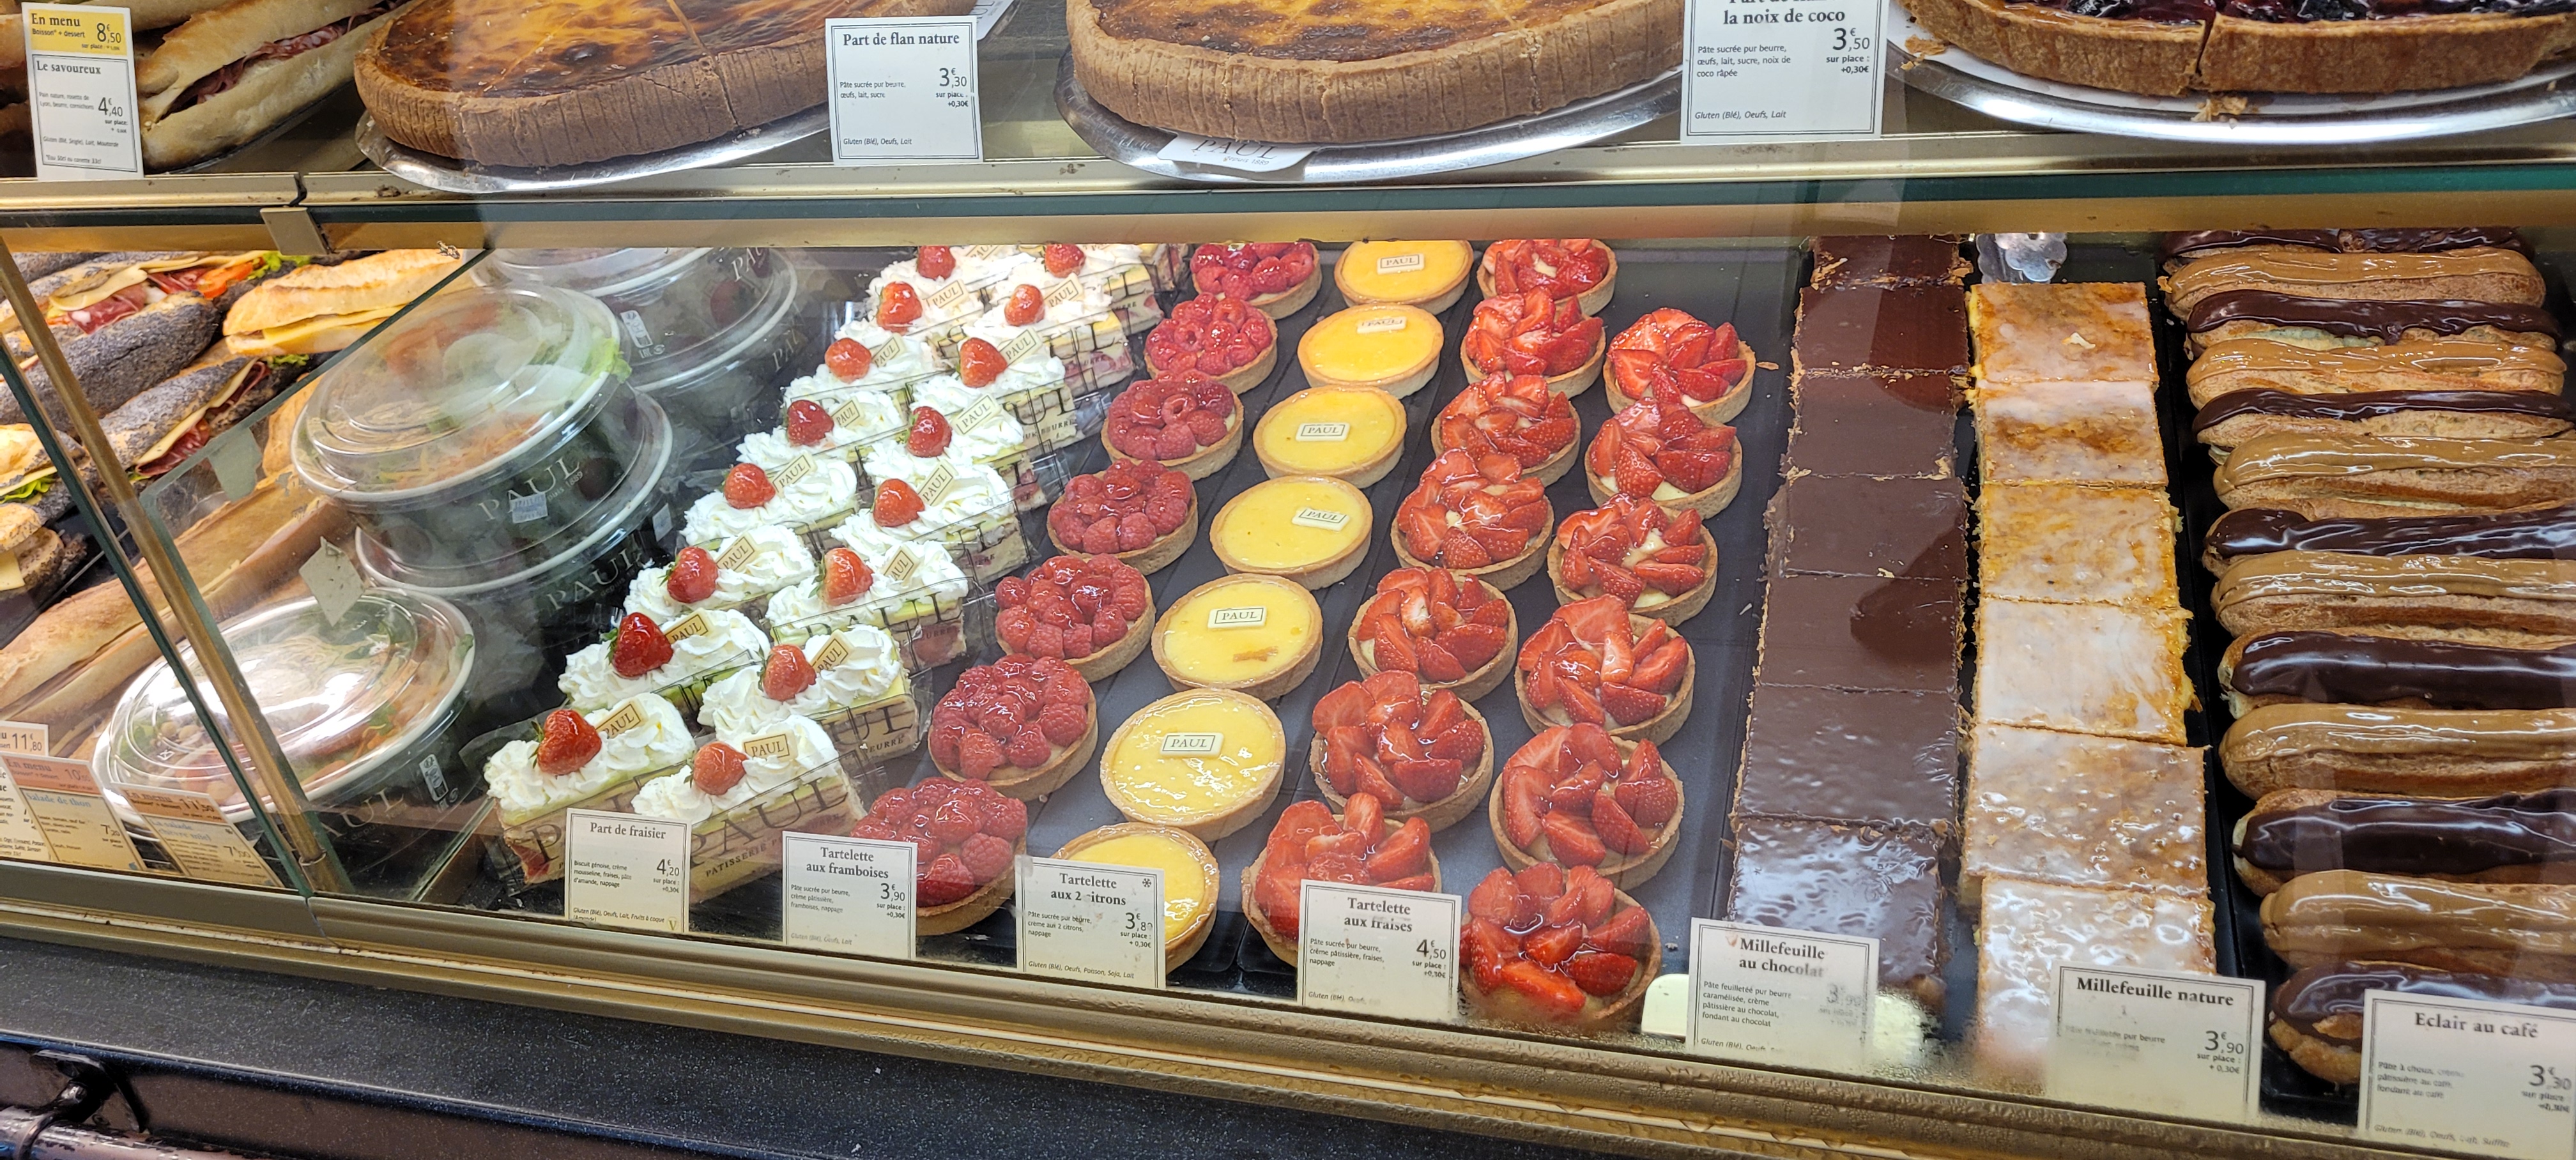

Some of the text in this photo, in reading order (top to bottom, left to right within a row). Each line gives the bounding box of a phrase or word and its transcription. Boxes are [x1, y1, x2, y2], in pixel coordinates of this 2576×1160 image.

[31, 13, 80, 27] En menu
[1723, 8, 1845, 25] la noix de coco
[843, 32, 959, 46] Part de flan nature
[1717, 45, 1742, 53] sucrée
[1744, 46, 1757, 54] pur
[1759, 45, 1787, 53] beurre,
[36, 61, 101, 74] Le savoureux
[1721, 56, 1735, 65] lait,
[1737, 57, 1760, 65] sucre,
[1842, 56, 1864, 65] place
[1716, 68, 1738, 79] râpée
[1841, 65, 1869, 74] +0,30€
[1722, 111, 1742, 120] (Blé),
[1744, 111, 1768, 119] Oeufs,
[1191, 139, 1276, 159] PAUL
[1386, 257, 1415, 266] PAUL
[932, 287, 959, 305] PAUL
[1048, 287, 1073, 307] PAUL
[874, 344, 895, 367] PAUL
[1006, 338, 1031, 360] PAUL
[836, 408, 855, 425] PAUL
[961, 404, 990, 427] PAUL
[779, 463, 806, 487] PAUL
[923, 473, 947, 501] PAUL
[1307, 511, 1338, 521] PAUL
[723, 545, 749, 570] PAUL
[546, 548, 641, 610] PAUL
[1222, 611, 1258, 621] PAUL
[671, 622, 702, 641] PAUL
[818, 648, 842, 671] PAUL
[751, 740, 785, 758] PAUL
[1170, 738, 1208, 748] PAUL
[24, 762, 52, 772] menu
[26, 792, 91, 807] Salade de thon
[590, 822, 666, 839] Part de fraisier
[705, 845, 767, 878] PATISSERIE
[820, 846, 874, 862] Tartelette
[806, 862, 889, 879] aux framboises
[1059, 873, 1117, 889] Tartelette
[831, 889, 850, 897] beurre,
[1051, 890, 1072, 900] aux
[1085, 891, 1126, 906] itrons
[1347, 897, 1411, 915] Tartelette
[1063, 923, 1084, 932] citrons,
[1344, 917, 1367, 927] aux
[1330, 950, 1361, 960] pâtissière,
[1359, 943, 1381, 952] beurre,
[1740, 937, 1825, 959] Millefeuille
[1309, 958, 1335, 966] nappage
[1739, 959, 1824, 977] au chocolat
[1064, 965, 1082, 973] Oeufs,
[1084, 966, 1106, 976] Poisson,
[1308, 991, 1329, 1000] Gluten
[1704, 981, 1767, 996] Pâte pur
[2077, 977, 2234, 1006] Millefeuille nature
[1703, 991, 1770, 1006] caramélisée, crème
[1703, 1000, 1735, 1012] pâtissière
[1748, 1007, 1779, 1018] chocolat,
[1702, 1011, 1729, 1021] fondant
[1742, 1016, 1771, 1027] chocolat
[2415, 1012, 2538, 1038] Eclair au café
[1701, 1038, 1724, 1047] Gluten
[2123, 1033, 2165, 1044] pur beurre
[2212, 1054, 2235, 1064] place
